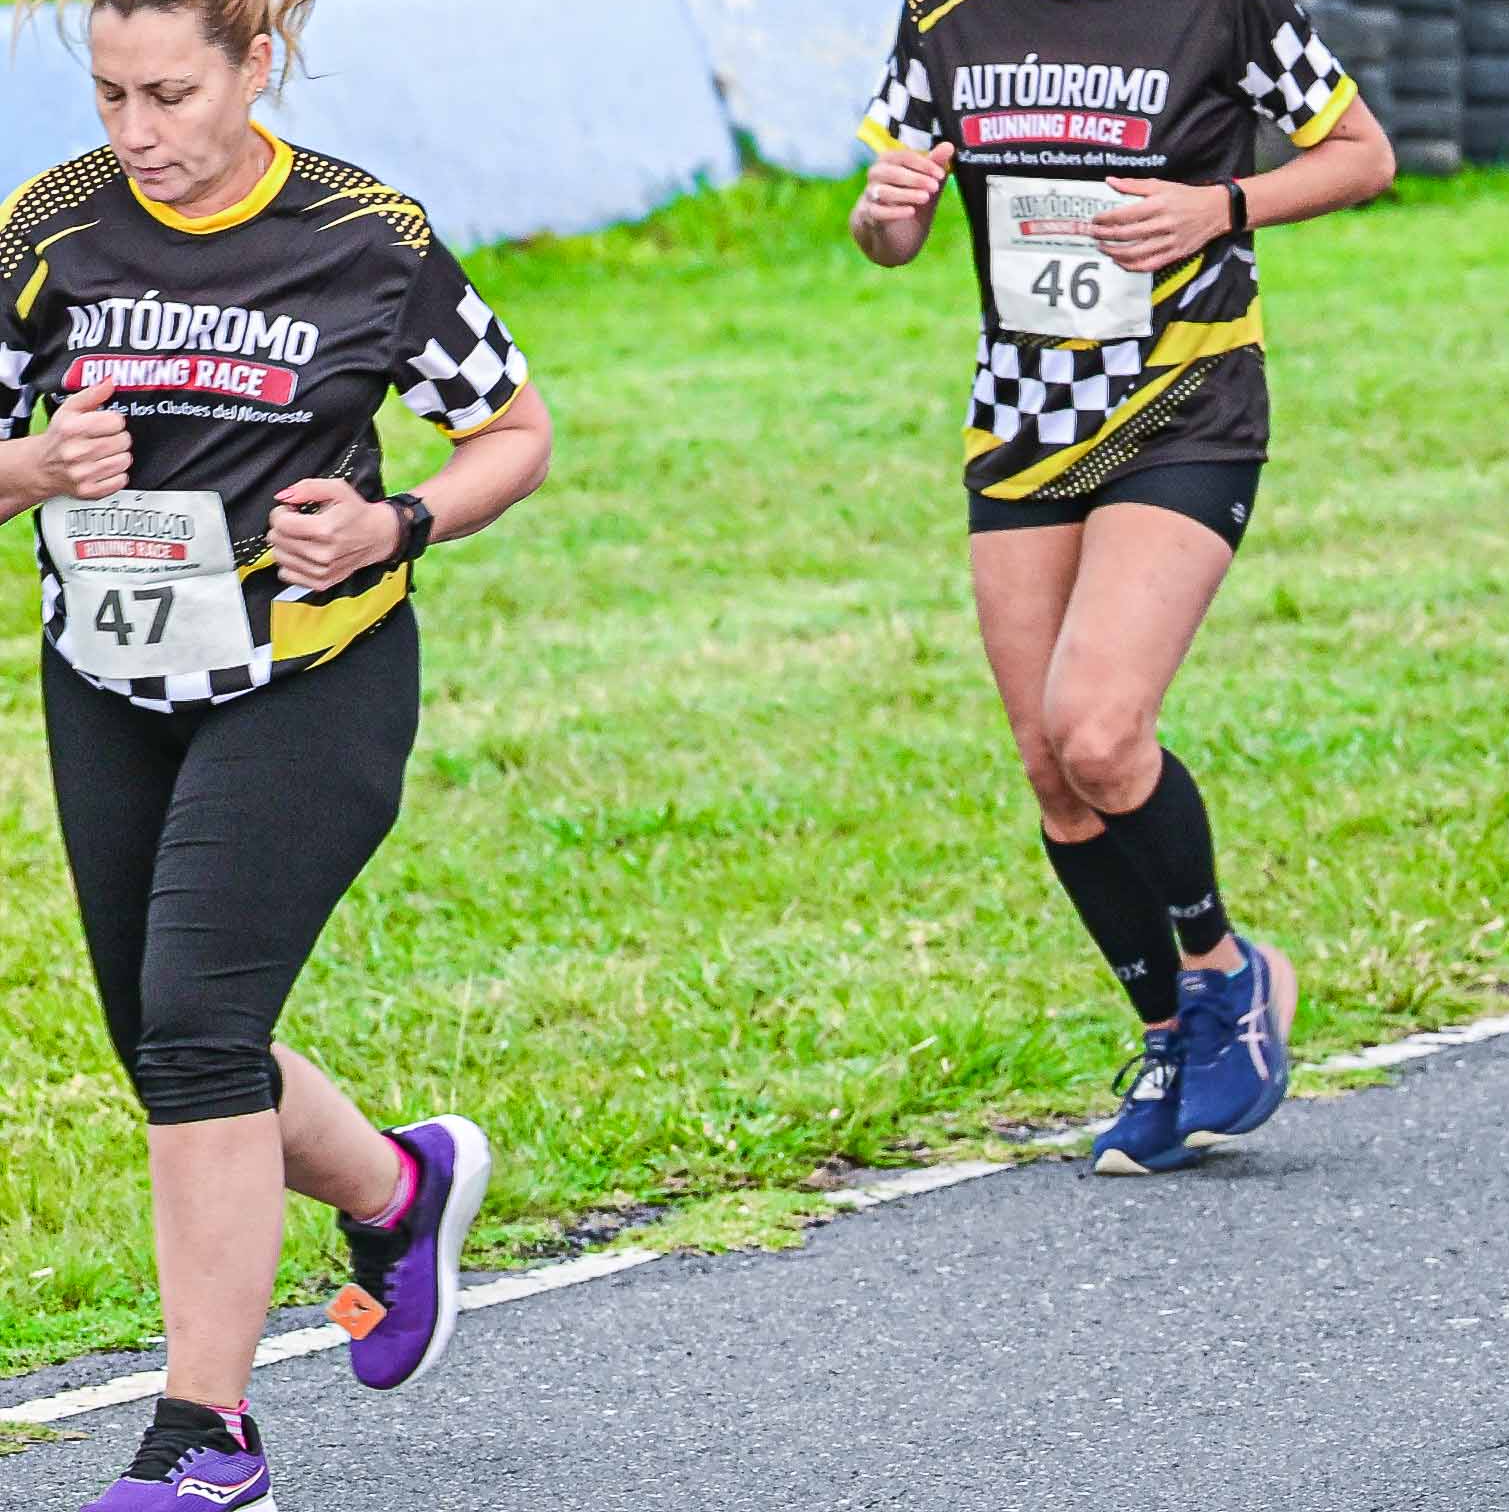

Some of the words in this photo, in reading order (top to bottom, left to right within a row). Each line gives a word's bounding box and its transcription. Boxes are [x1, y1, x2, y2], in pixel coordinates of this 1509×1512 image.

[952, 53, 1170, 115] AUTÓDROMO
[978, 114, 1066, 143] RUNNING
[1068, 115, 1126, 145] RACE
[1031, 260, 1101, 310] 46
[66, 289, 320, 365] AUTÓDROMO
[194, 359, 269, 397] RACE
[130, 401, 155, 417] los
[157, 400, 211, 418] Clubes
[96, 585, 174, 646] 47
